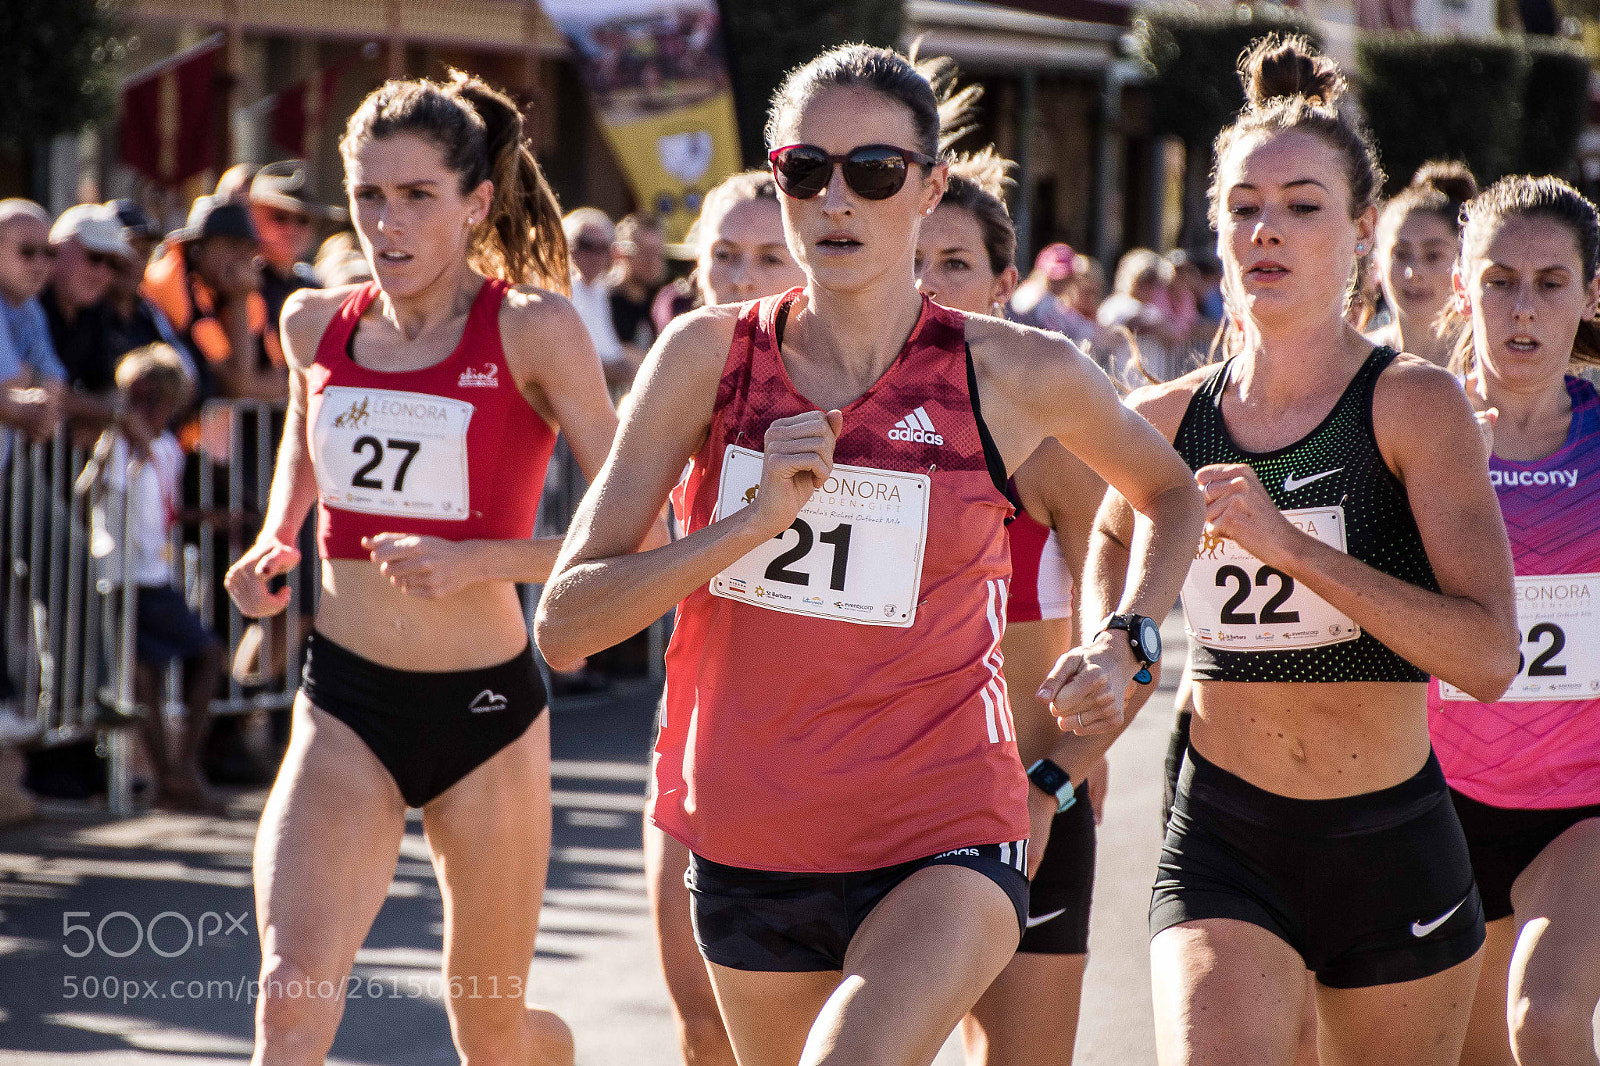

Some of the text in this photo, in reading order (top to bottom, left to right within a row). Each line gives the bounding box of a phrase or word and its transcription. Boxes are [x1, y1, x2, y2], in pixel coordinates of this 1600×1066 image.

[373, 400, 448, 422] LEONORA
[888, 427, 944, 446] adidas
[351, 435, 421, 492] 27
[814, 476, 901, 503] ONORA
[1489, 469, 1579, 488] aucony
[808, 495, 857, 508] OLDEN
[764, 517, 853, 592] 21
[1215, 564, 1300, 625] 22
[1515, 584, 1591, 601] EONORA
